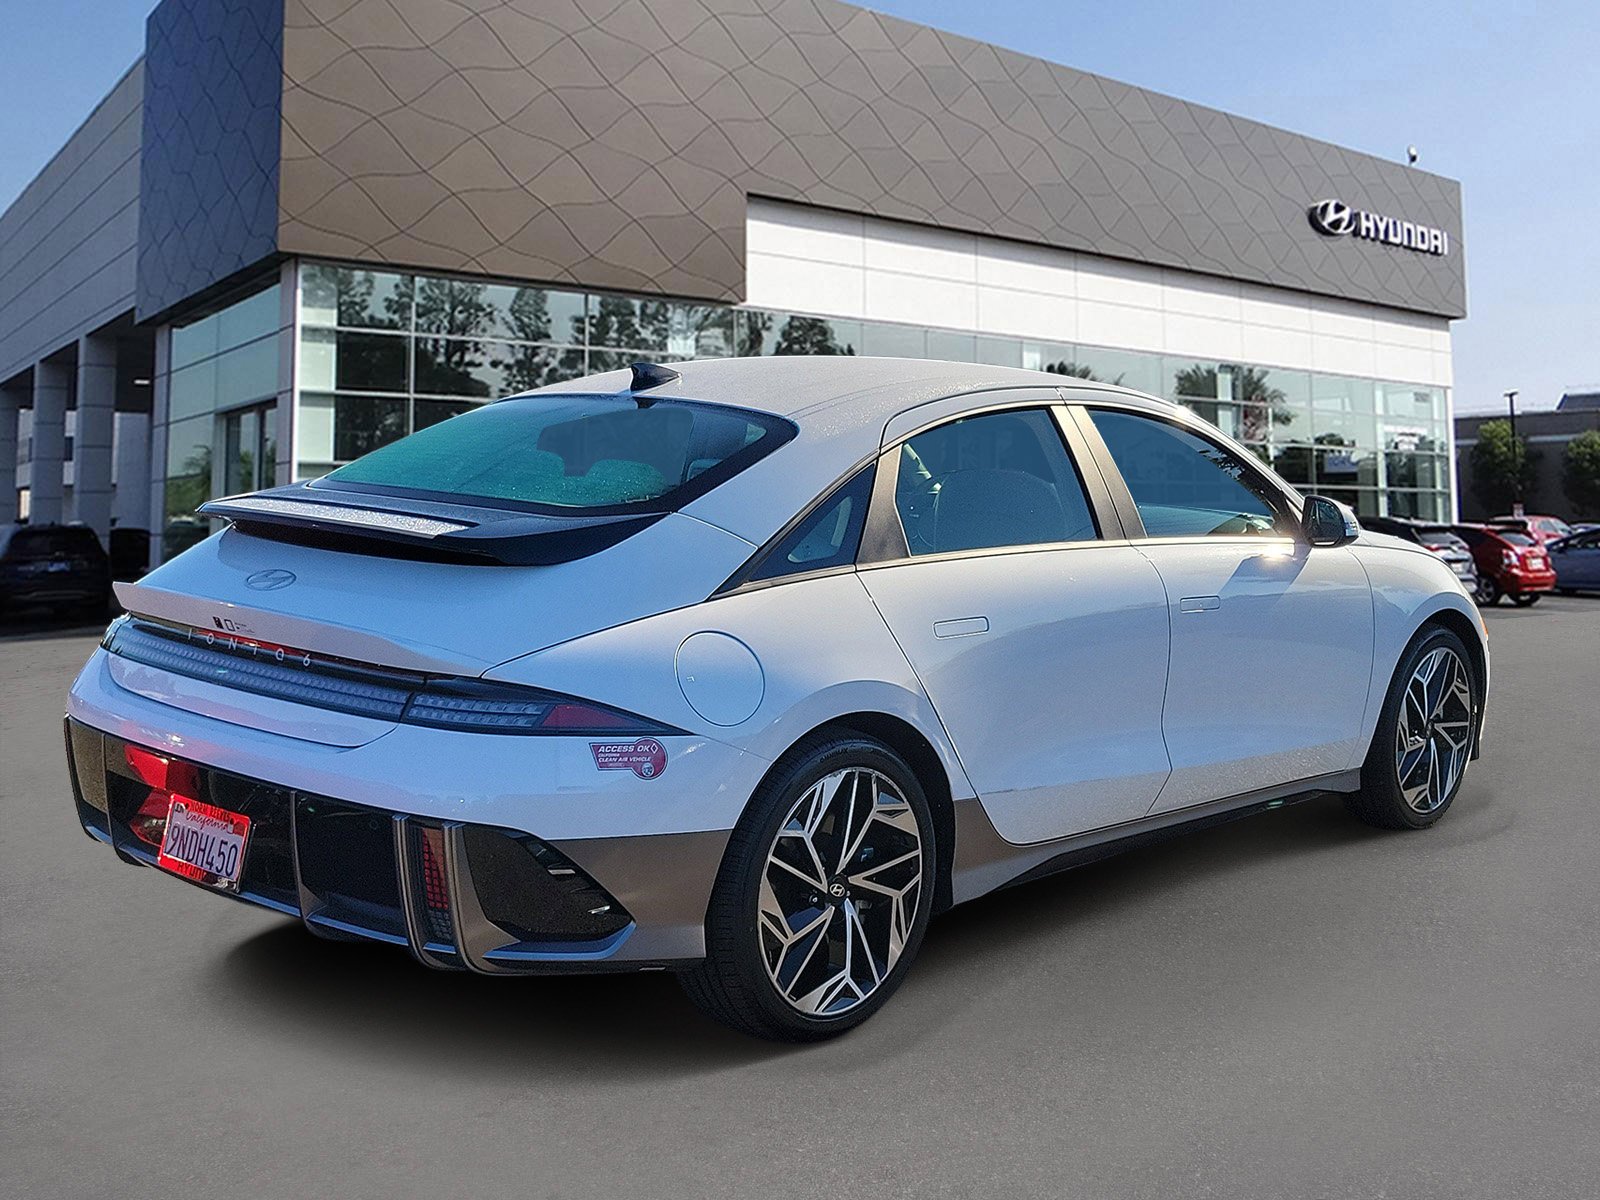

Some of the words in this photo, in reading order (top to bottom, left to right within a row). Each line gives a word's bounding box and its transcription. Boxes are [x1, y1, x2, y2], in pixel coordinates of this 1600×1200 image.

[1360, 210, 1448, 255] HYUNDAI
[598, 745, 635, 753] ACCESS
[186, 811, 229, 830] California
[166, 824, 238, 877] 9NDH450
